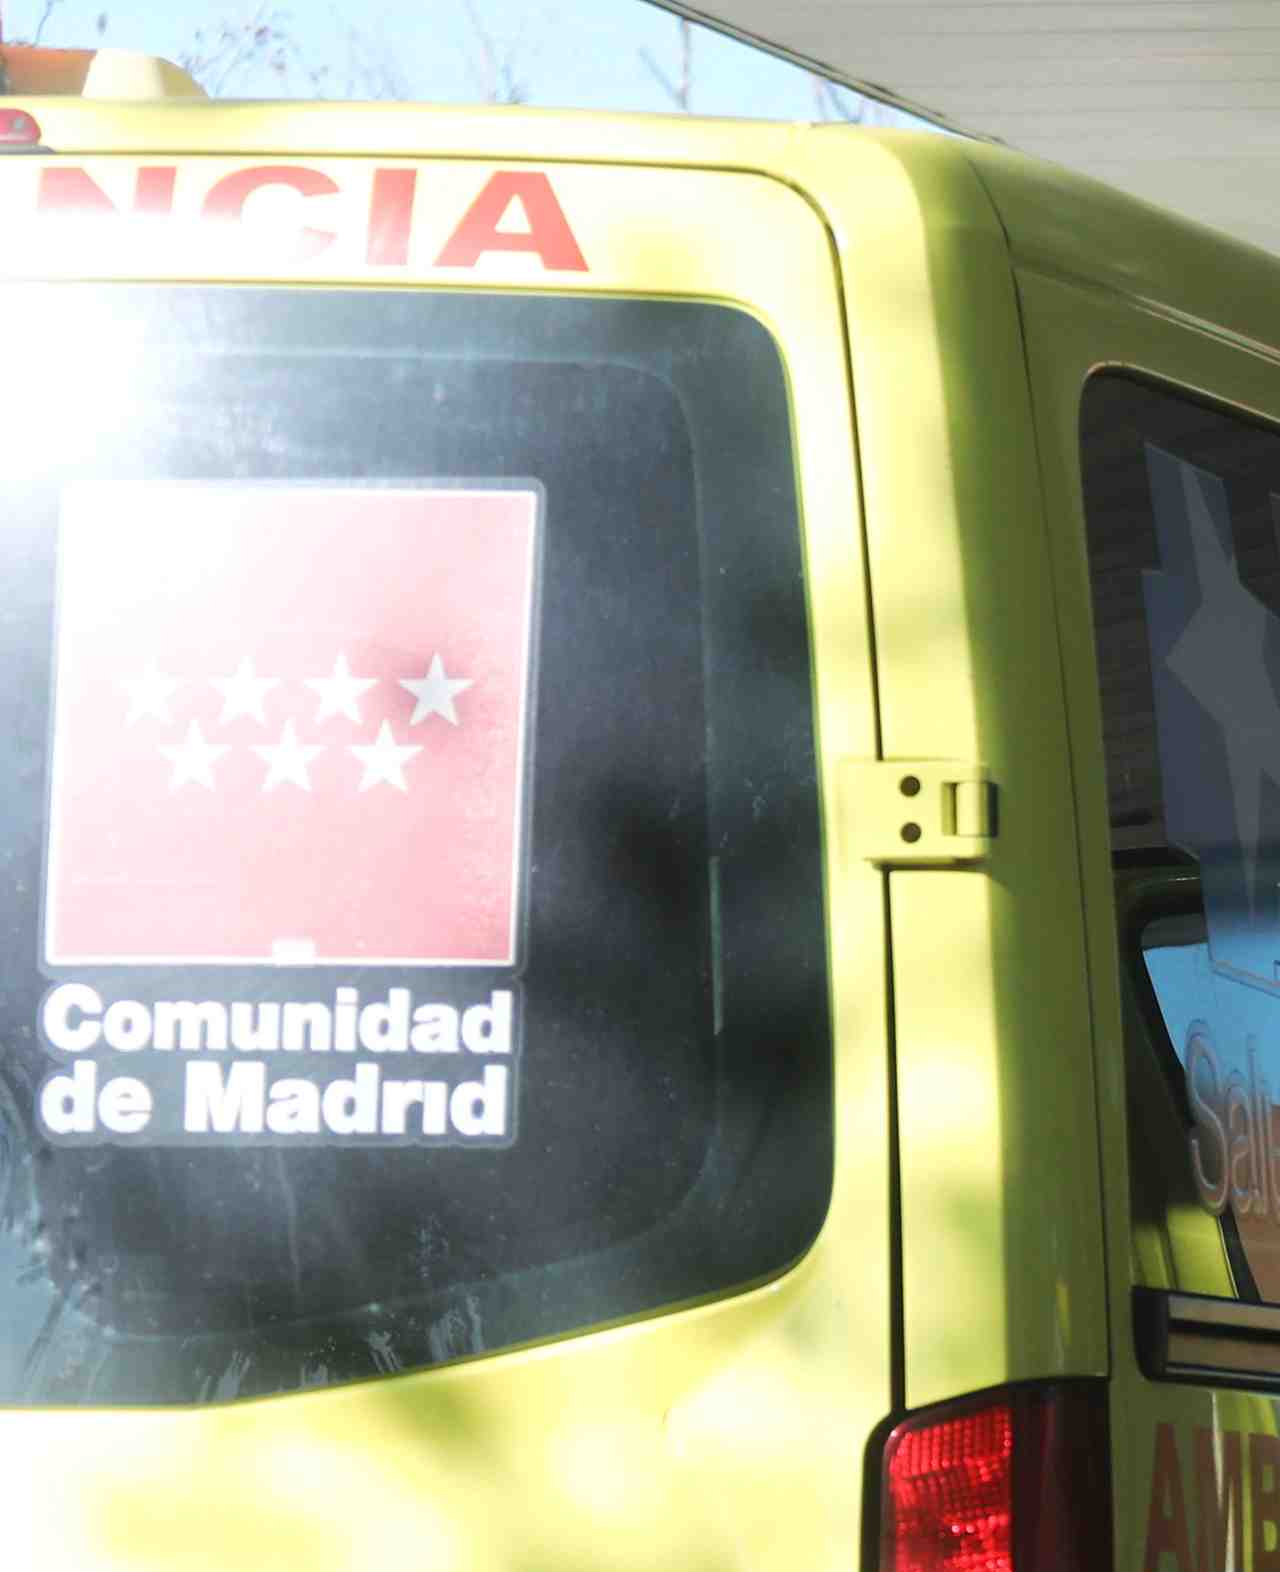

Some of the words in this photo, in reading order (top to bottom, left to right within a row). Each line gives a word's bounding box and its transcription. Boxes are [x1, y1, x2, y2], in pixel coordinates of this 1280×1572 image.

[43, 983, 513, 1053] Comunidad
[40, 1060, 152, 1133] de
[184, 1061, 508, 1136] Madrid
